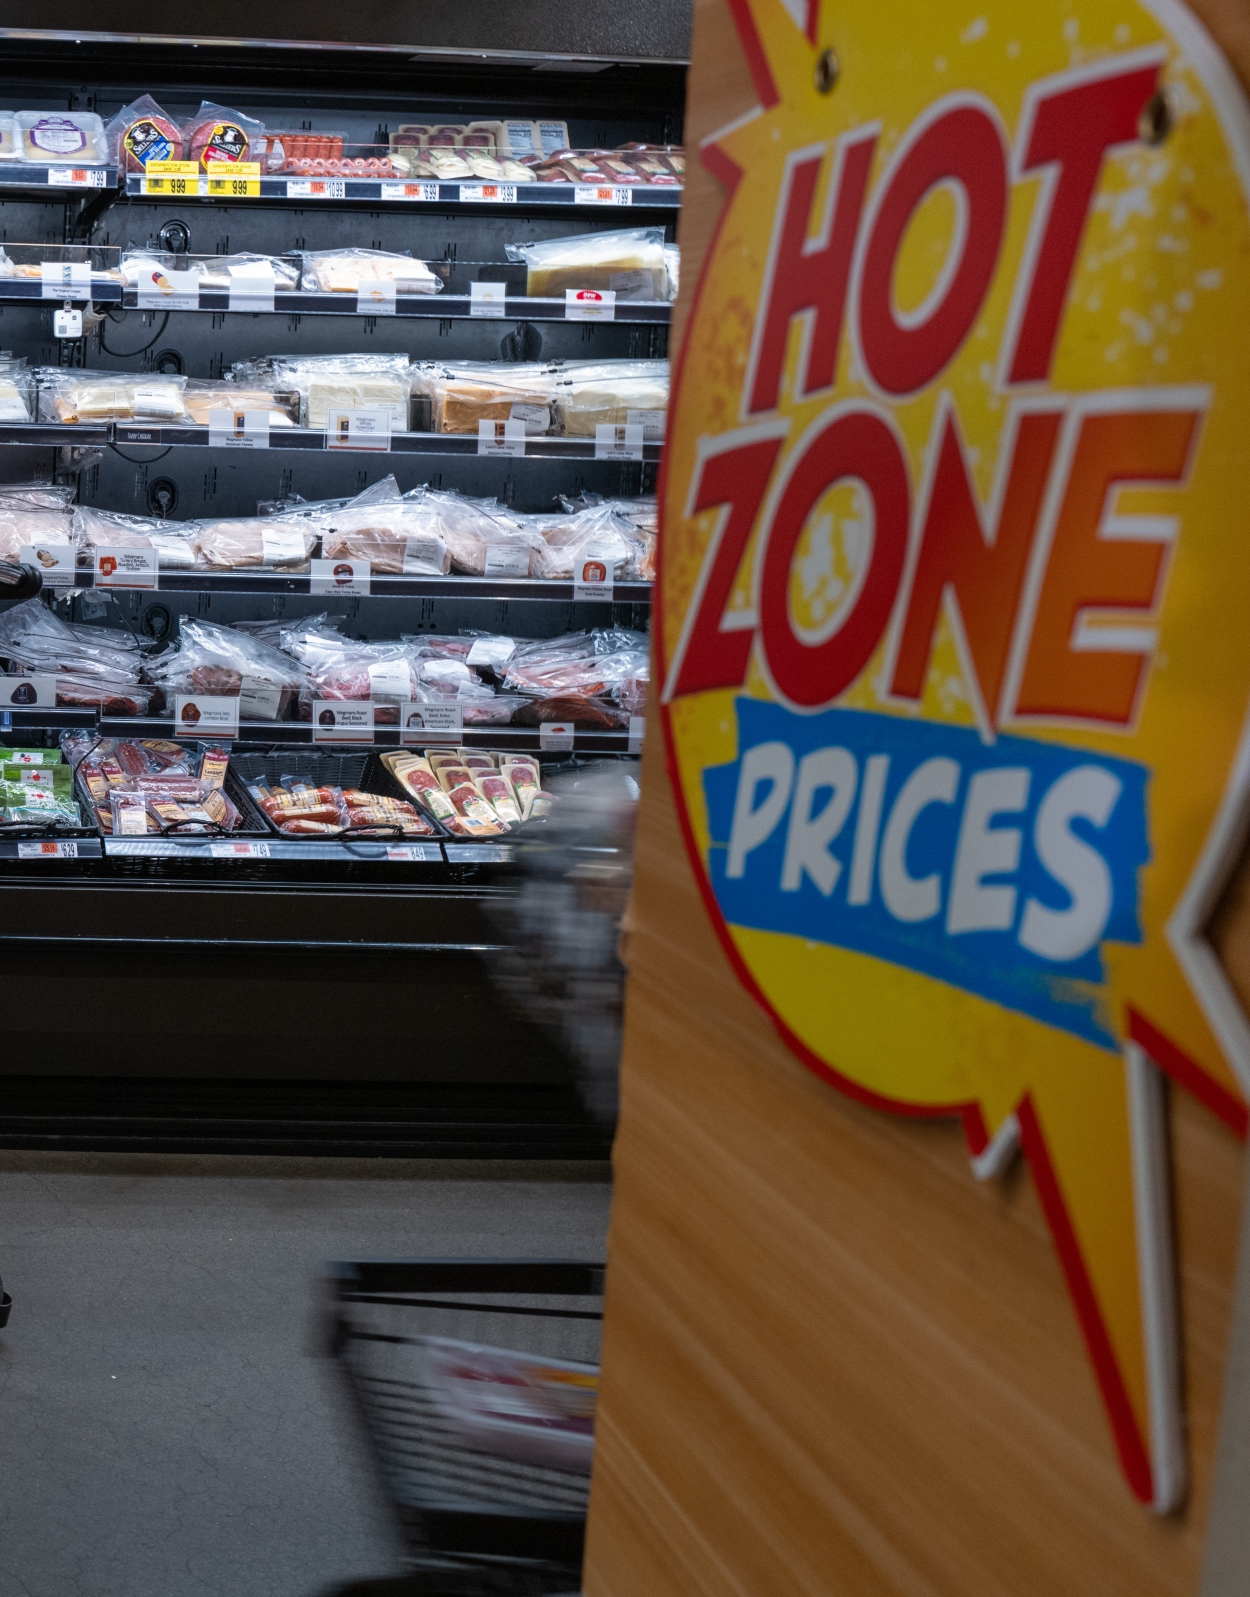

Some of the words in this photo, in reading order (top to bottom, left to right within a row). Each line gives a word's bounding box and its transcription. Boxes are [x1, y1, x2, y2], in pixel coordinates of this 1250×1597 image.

[744, 48, 1166, 420] HOT
[662, 384, 1213, 744] ZONE
[726, 741, 1123, 962] PRICES
